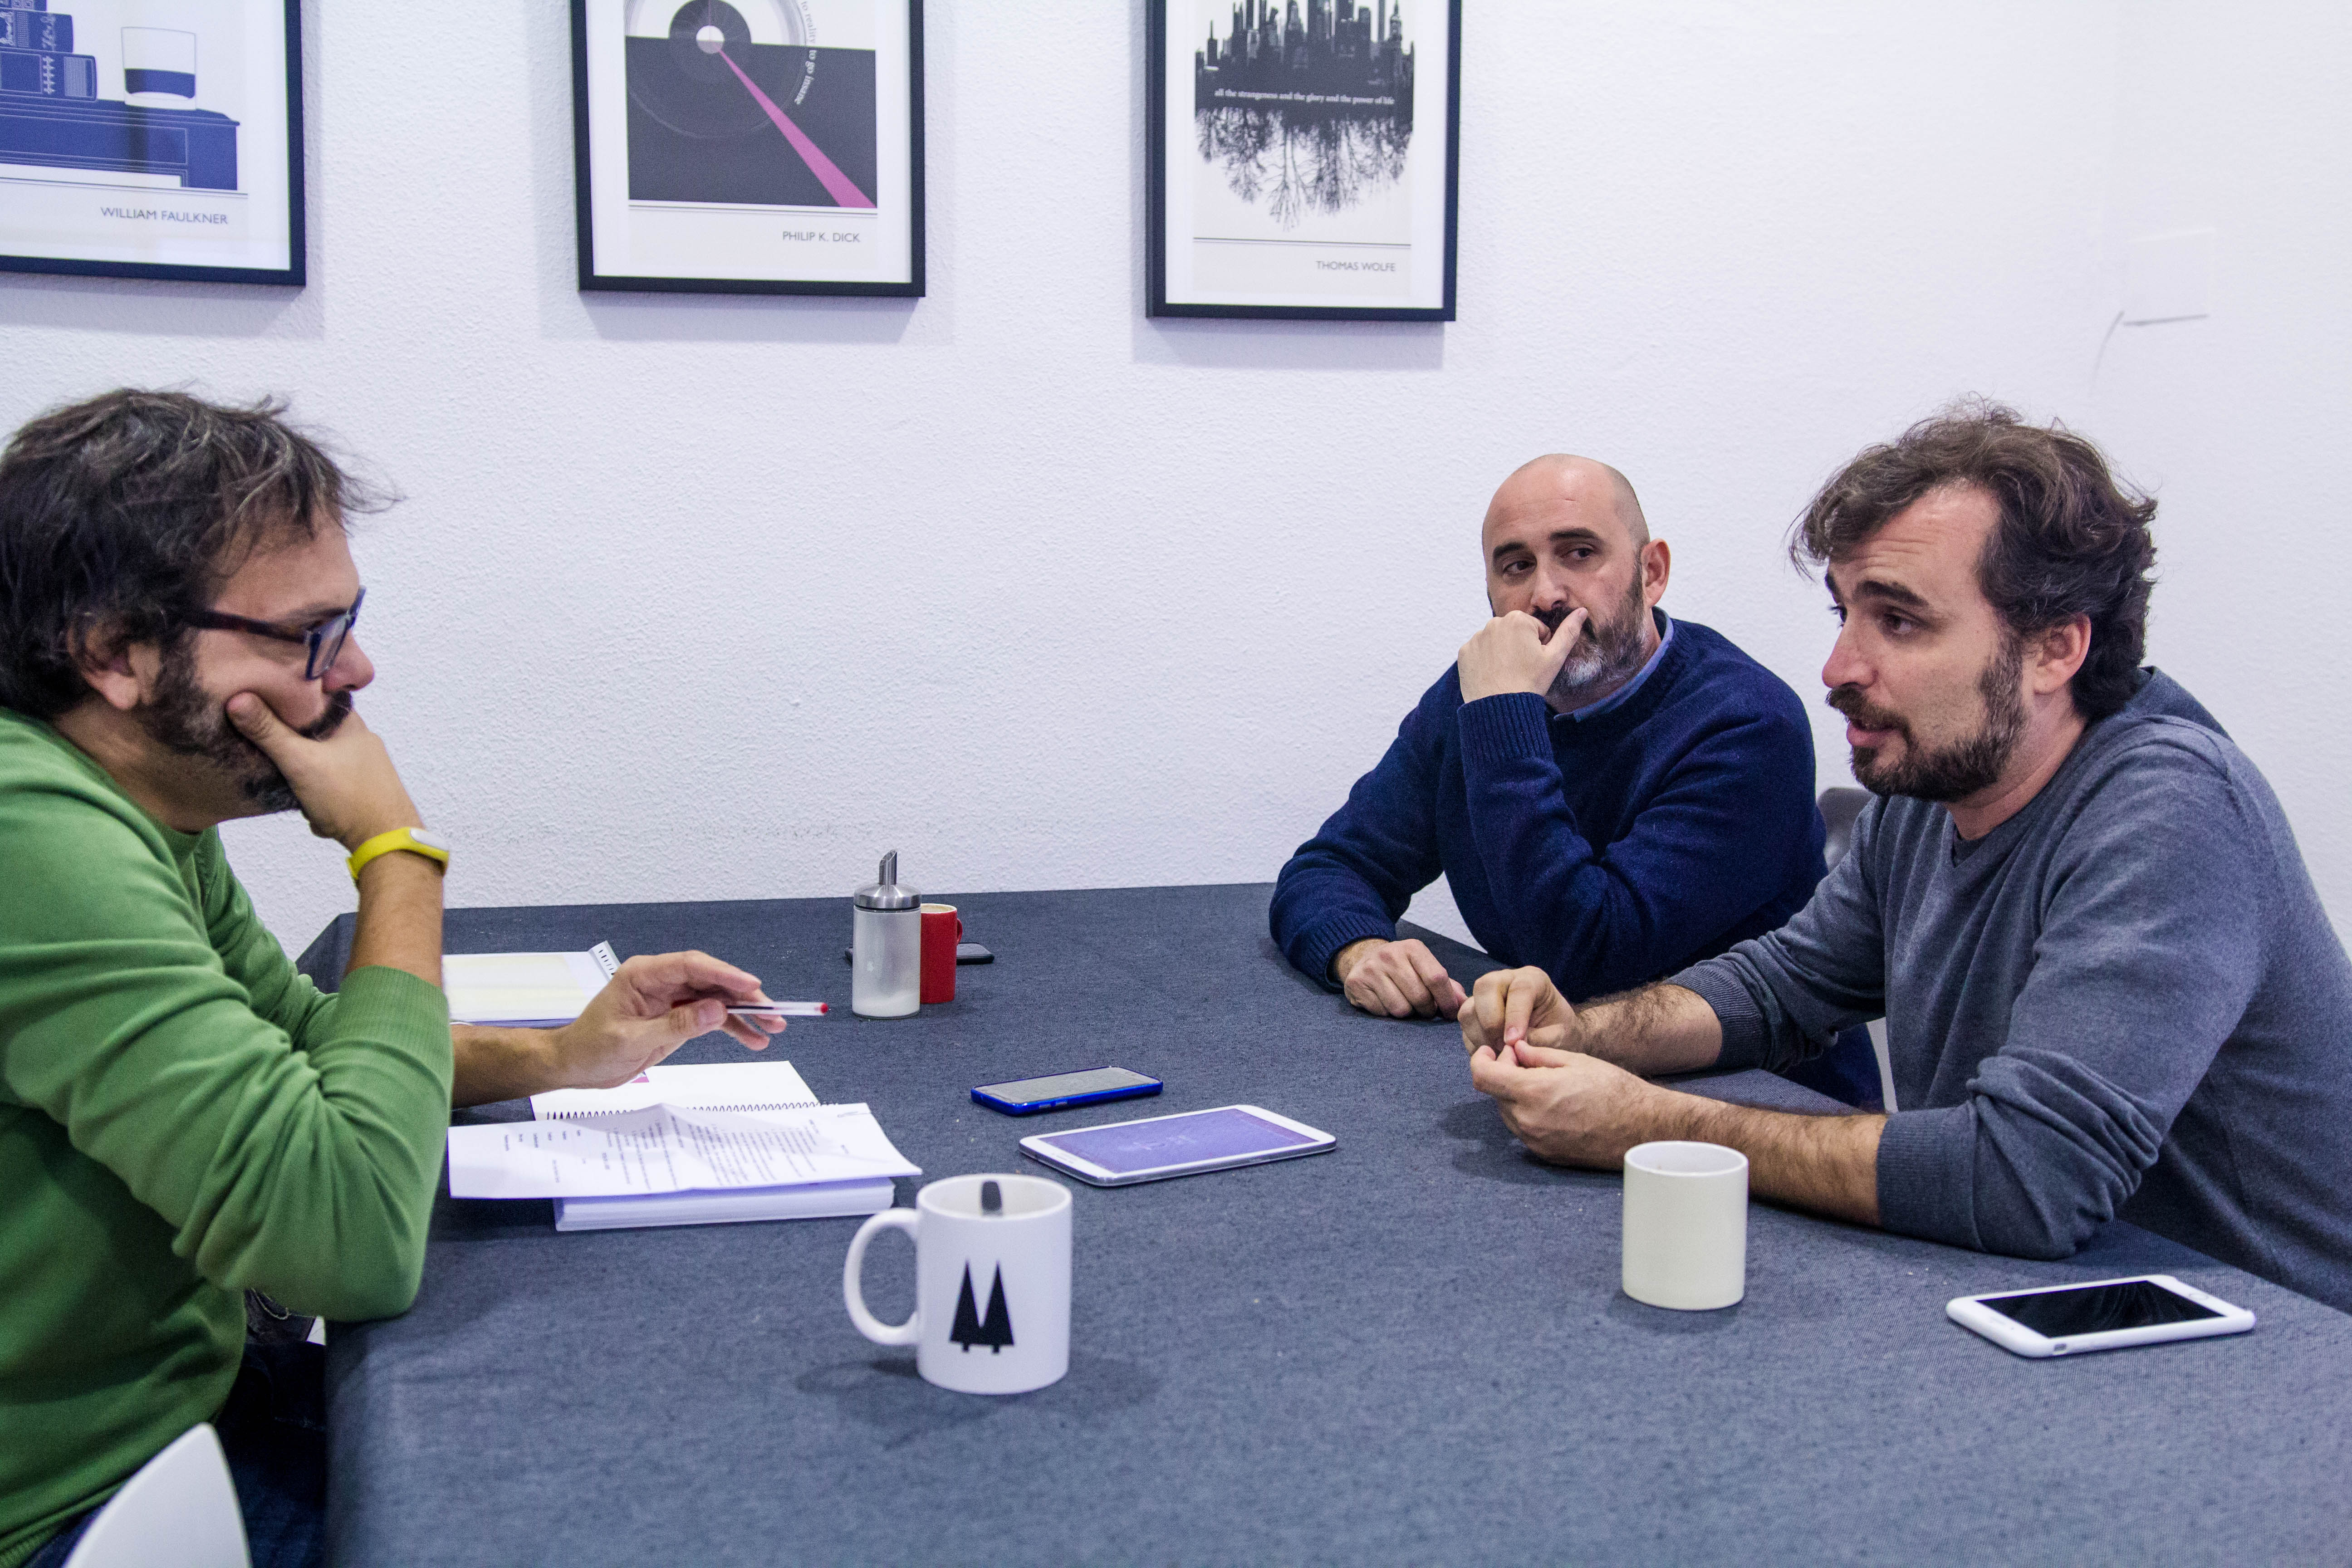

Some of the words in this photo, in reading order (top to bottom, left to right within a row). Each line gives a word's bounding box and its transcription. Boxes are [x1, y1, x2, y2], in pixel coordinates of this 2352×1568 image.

[800, 1, 808, 11] to
[805, 13, 817, 44] reality
[808, 49, 817, 60] to
[805, 60, 815, 74] go
[794, 75, 814, 105] insane
[1214, 88, 1224, 97] all
[1225, 88, 1237, 97] the
[1238, 91, 1278, 100] strangeness
[1279, 92, 1293, 100] and
[1294, 92, 1306, 100] the
[1306, 93, 1325, 103] glory
[1325, 94, 1339, 102] and
[1340, 94, 1351, 103] the
[1352, 97, 1374, 105] power
[1374, 96, 1383, 104] of
[1383, 96, 1395, 105] life
[100, 206, 157, 220] WILLIAM
[161, 210, 228, 224] FAULKNER
[783, 231, 815, 241] PHILIP
[818, 232, 829, 241] K.
[833, 232, 860, 243] DICK
[1315, 261, 1358, 271] THOMAS
[1361, 262, 1396, 272] WOLFE
